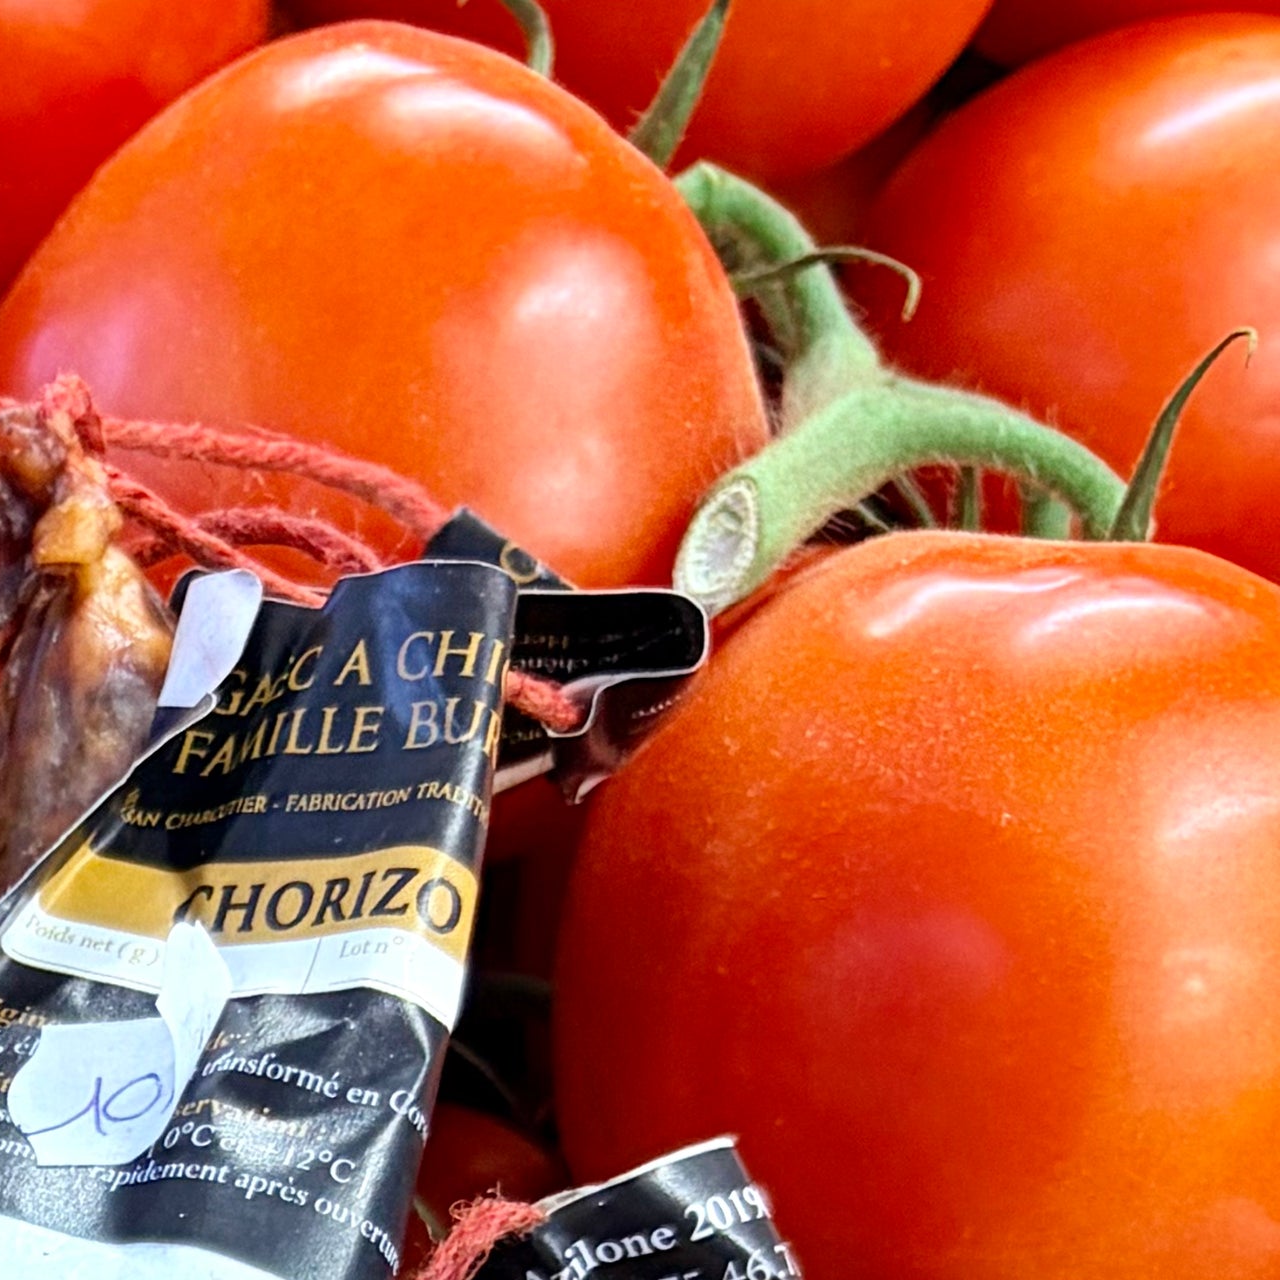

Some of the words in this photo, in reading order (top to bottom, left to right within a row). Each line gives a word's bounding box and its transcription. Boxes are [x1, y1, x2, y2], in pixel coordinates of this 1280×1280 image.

[334, 638, 373, 686] A
[285, 785, 409, 813] FABRICATION
[172, 866, 463, 935] CHORIZO
[81, 928, 114, 954] net
[339, 938, 369, 959] Lot
[346, 1087, 380, 1107] en
[88, 1158, 230, 1190] rapidement
[234, 1170, 310, 1207] après
